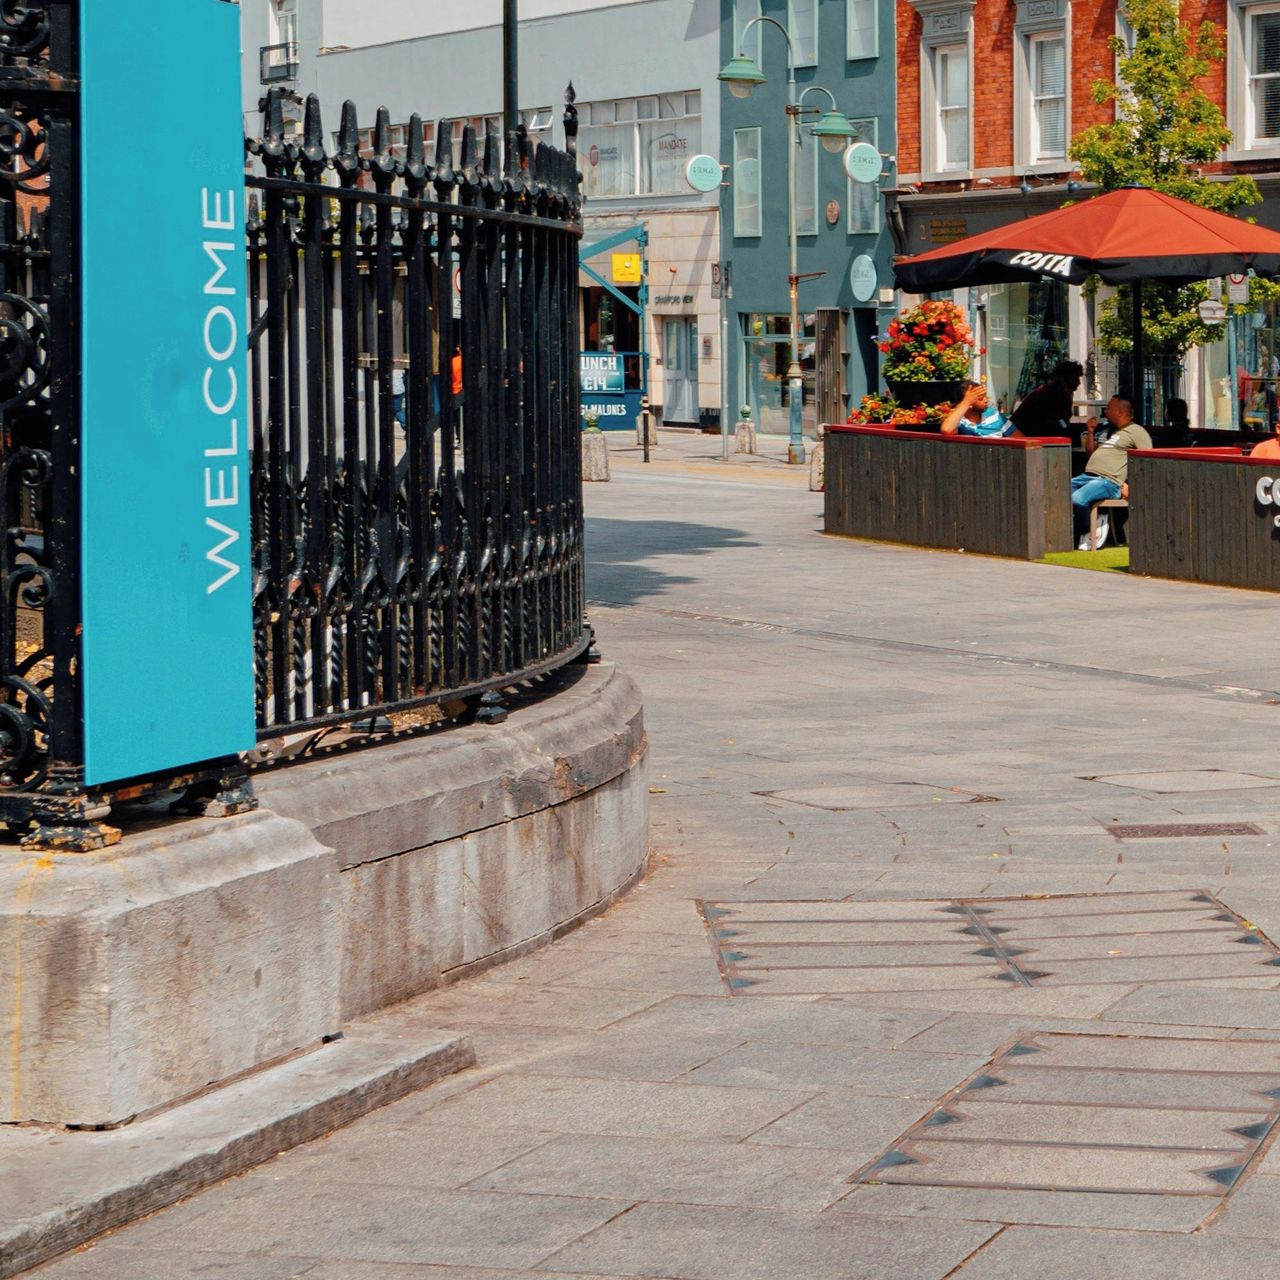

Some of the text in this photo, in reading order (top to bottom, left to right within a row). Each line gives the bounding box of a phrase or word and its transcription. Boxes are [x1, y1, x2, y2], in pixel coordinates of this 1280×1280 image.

[1009, 251, 1074, 277] COSTA
[581, 356, 617, 370] UNCH
[203, 187, 240, 595] WELCOME
